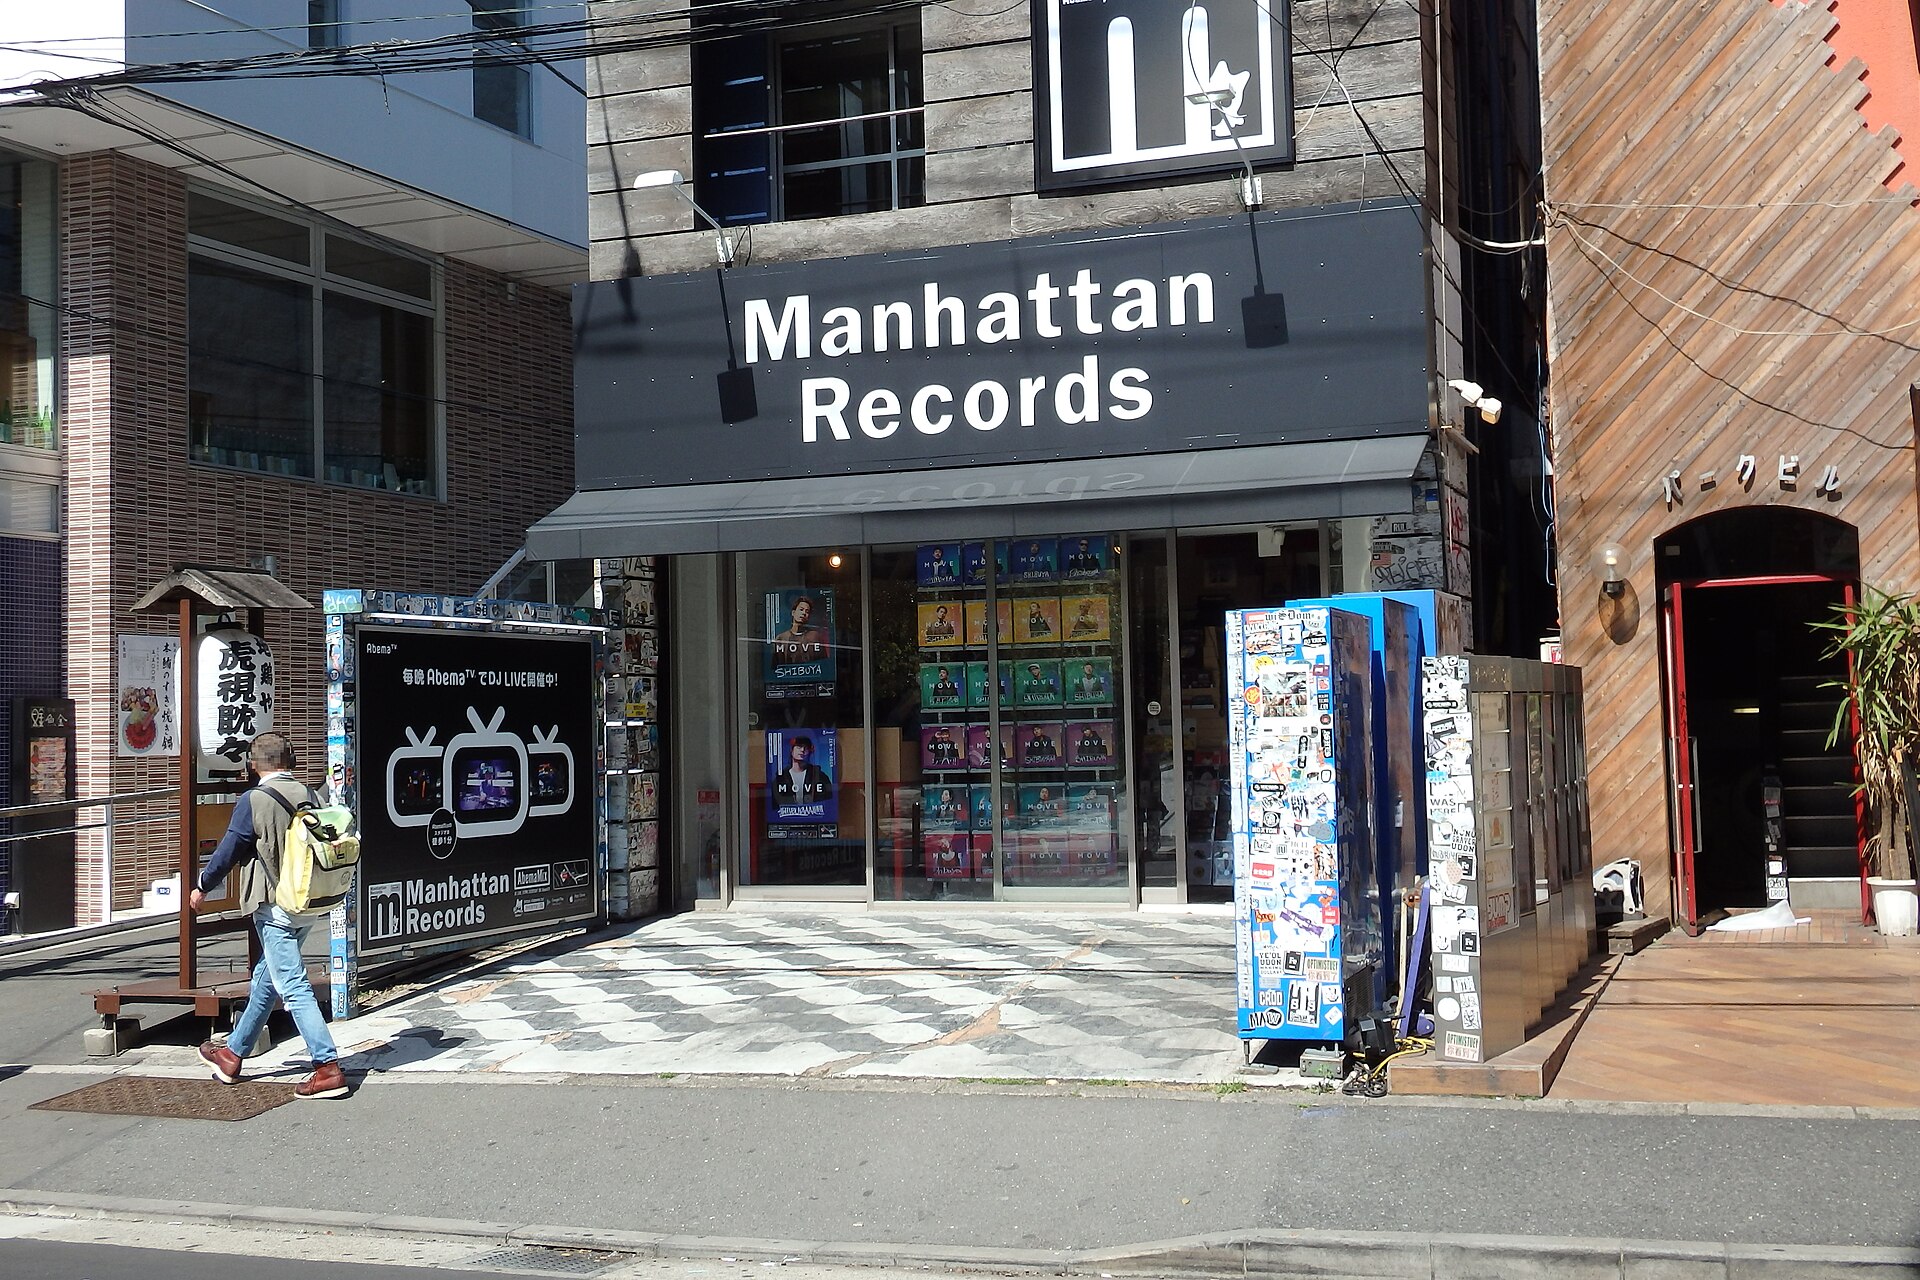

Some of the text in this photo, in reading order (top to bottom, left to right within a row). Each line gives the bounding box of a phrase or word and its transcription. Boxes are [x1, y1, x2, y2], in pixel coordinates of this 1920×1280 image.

[744, 268, 1215, 364] Manhattan
[801, 355, 1154, 443] Records
[1663, 454, 1839, 502] パークビル
[366, 643, 398, 655] AbemaTV
[776, 643, 821, 653] MOVE
[403, 668, 558, 688] 毎晩 AbemaTV でDJ LIVE開催中!
[775, 665, 822, 678] SHIBUYA
[778, 783, 823, 793] MOVE
[517, 869, 548, 885] AbemaMix
[406, 873, 510, 906] Manhattan
[406, 900, 486, 935] Records
